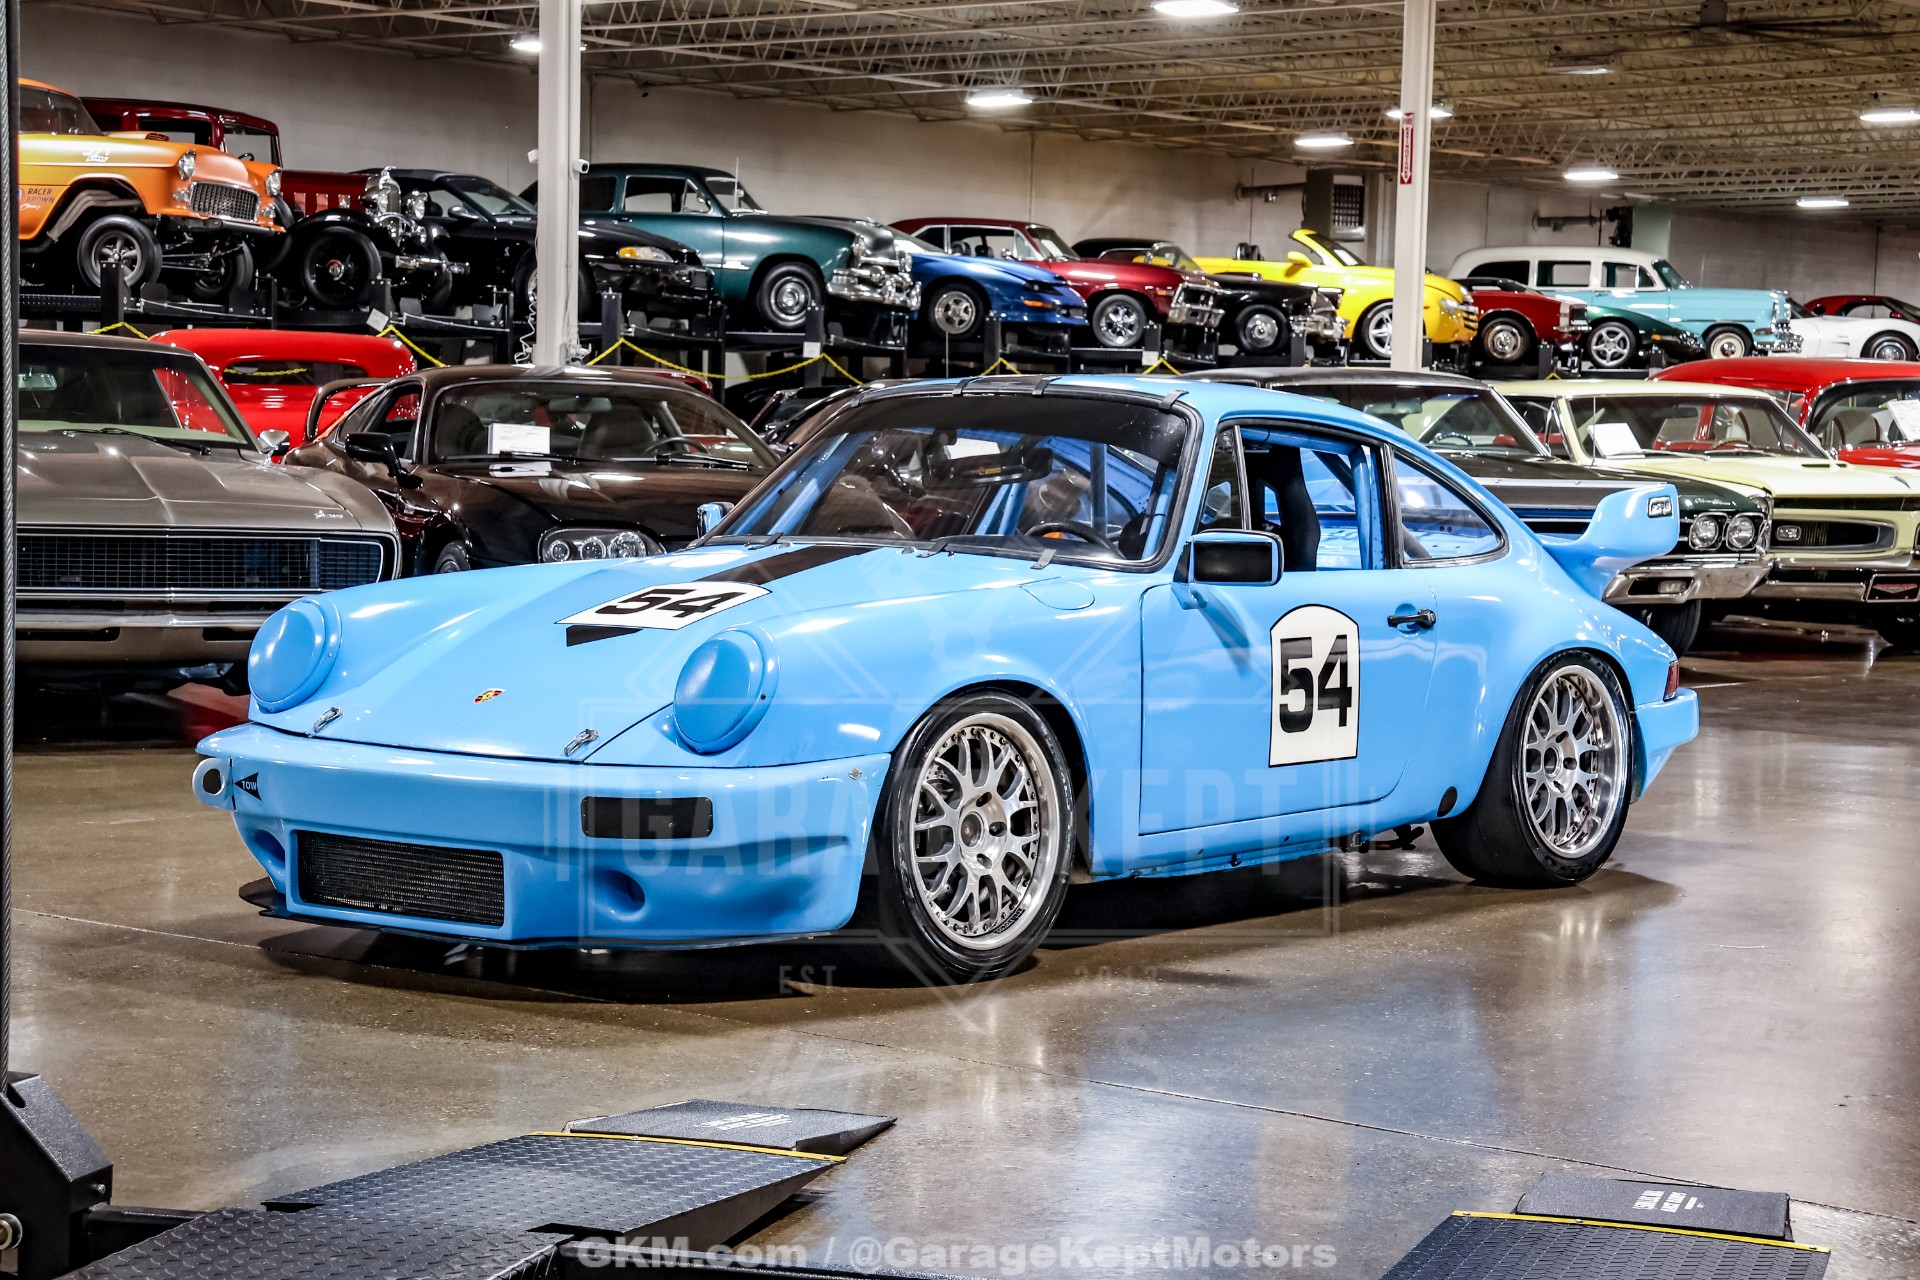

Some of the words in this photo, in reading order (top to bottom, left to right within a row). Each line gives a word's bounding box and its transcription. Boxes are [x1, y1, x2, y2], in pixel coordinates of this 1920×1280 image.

[594, 588, 747, 618] 54
[1279, 634, 1353, 734] 54
[241, 780, 257, 791] TOW
